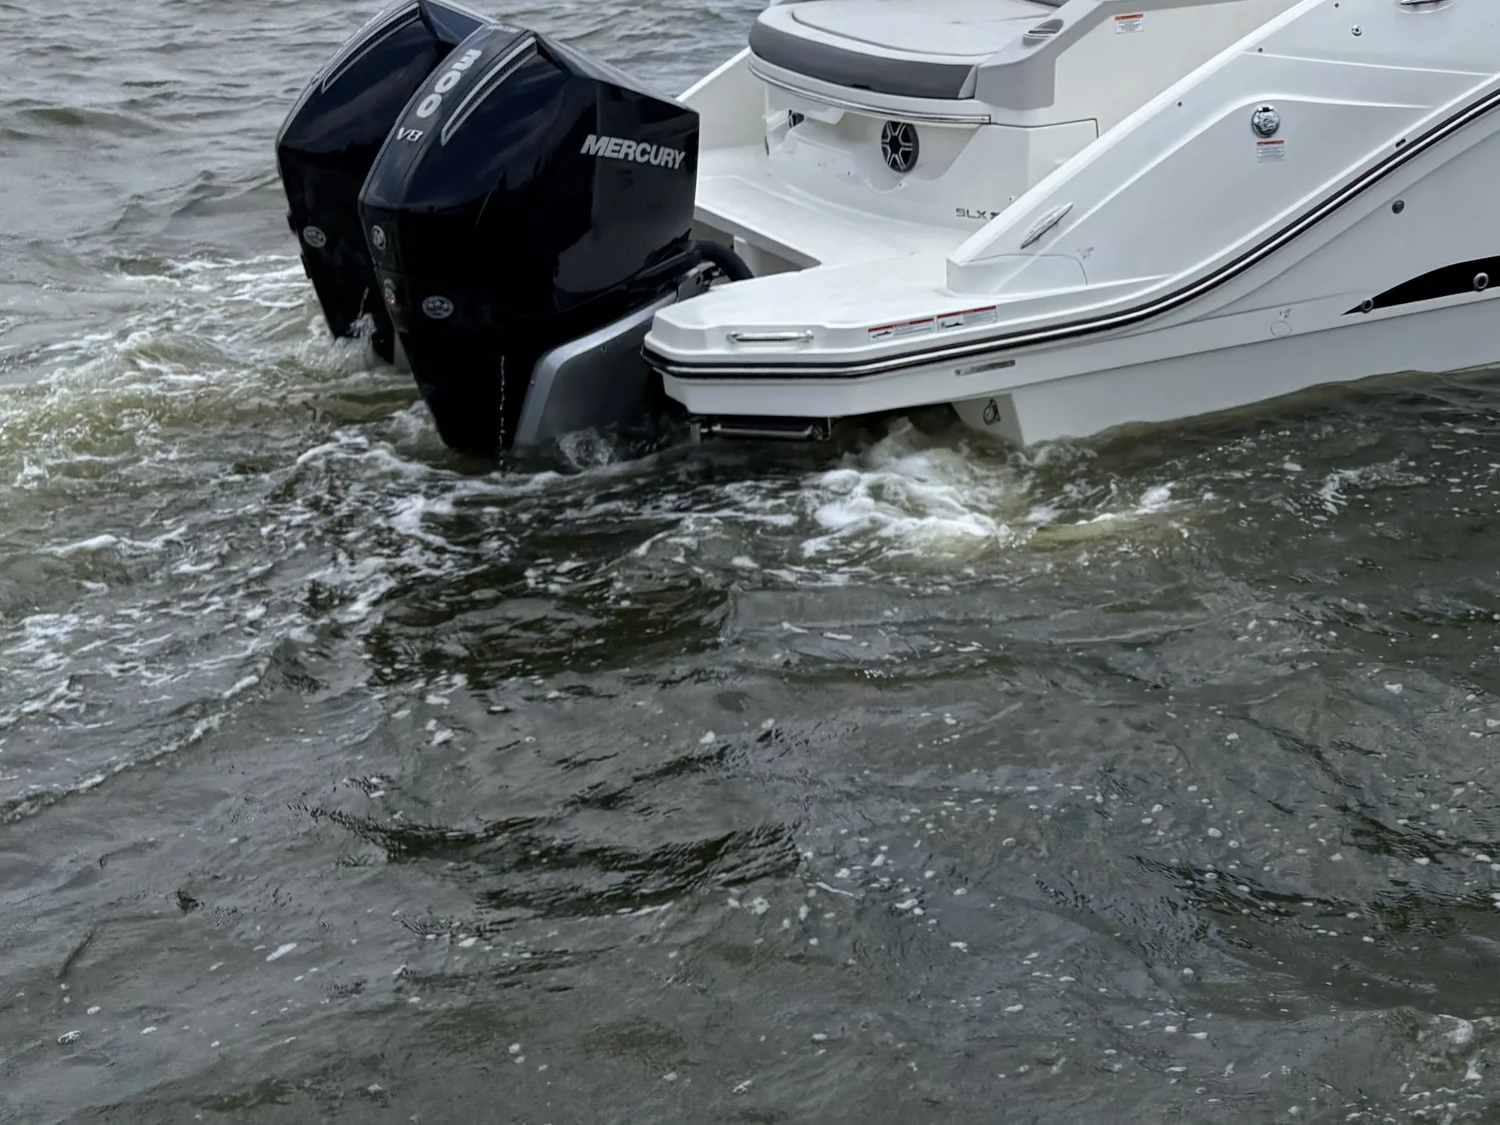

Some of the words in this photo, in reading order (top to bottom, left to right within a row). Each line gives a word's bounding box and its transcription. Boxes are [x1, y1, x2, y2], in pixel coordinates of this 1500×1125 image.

[416, 48, 483, 119] 300
[396, 126, 424, 143] V8
[580, 133, 686, 170] MERCURY
